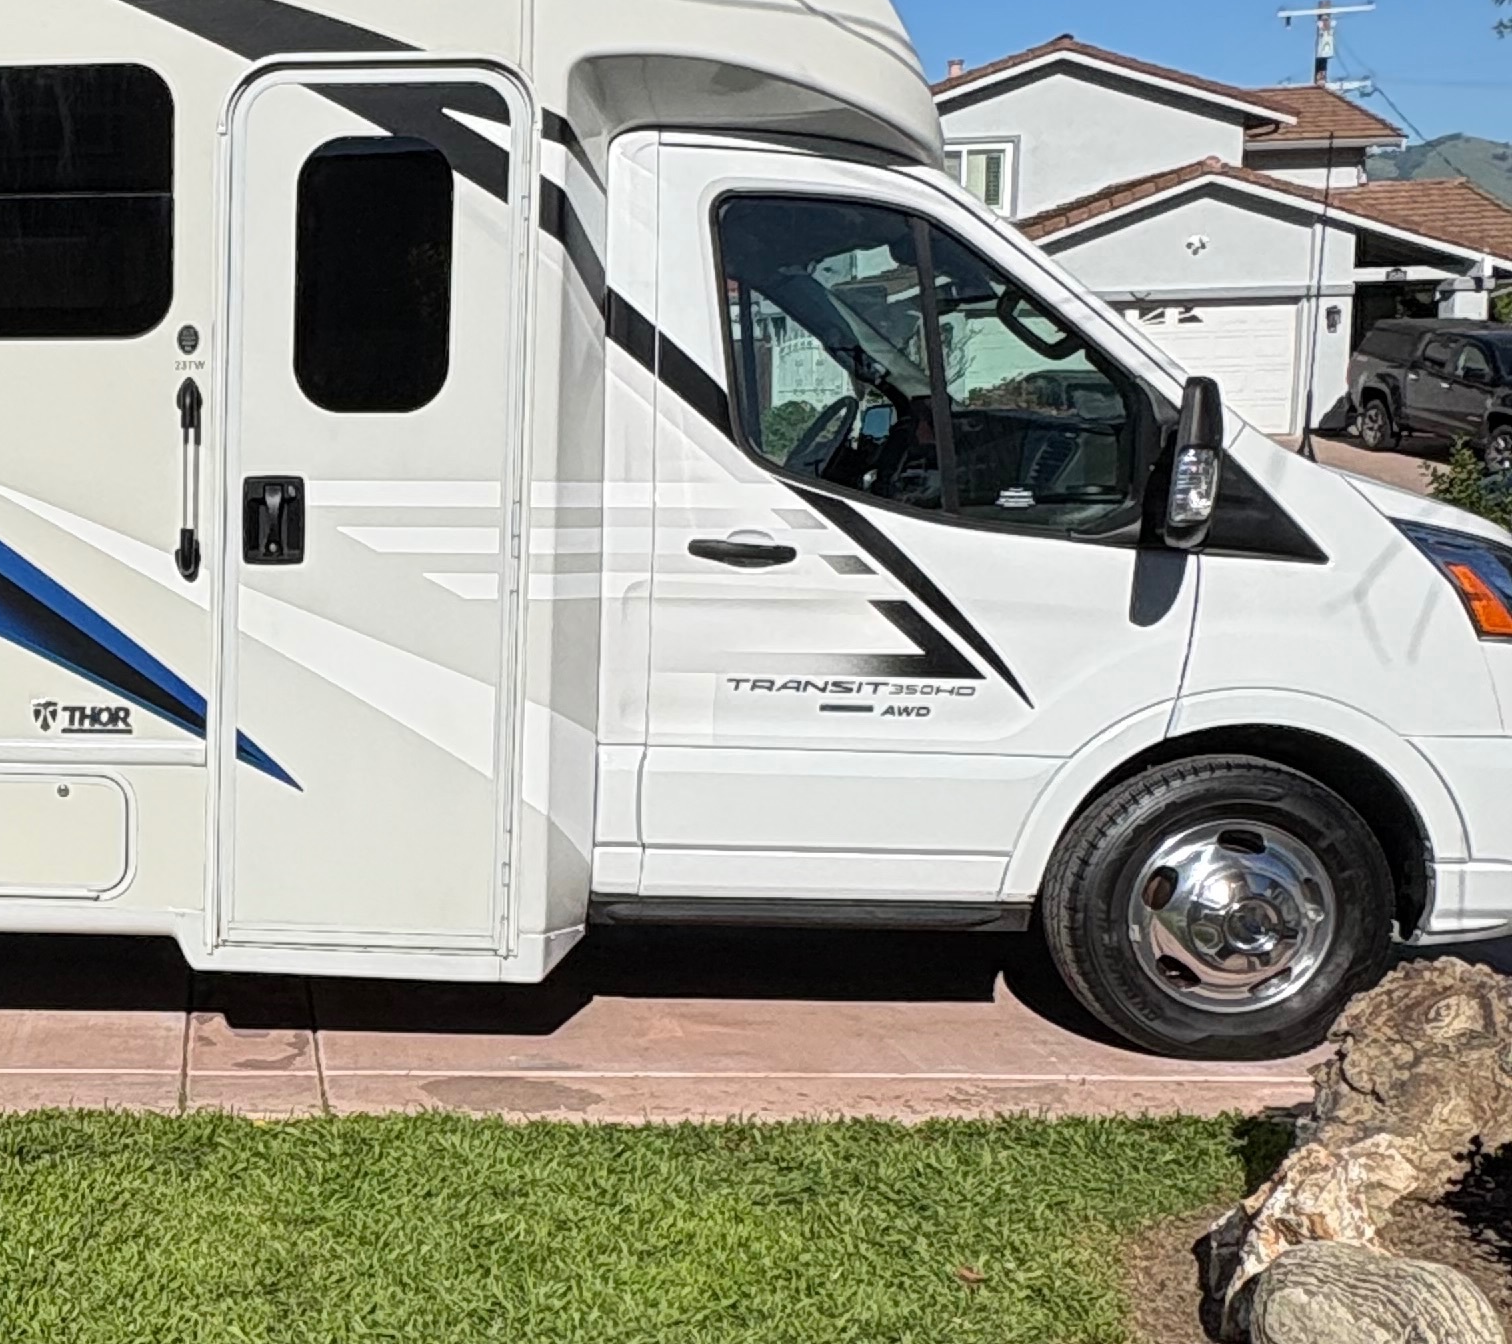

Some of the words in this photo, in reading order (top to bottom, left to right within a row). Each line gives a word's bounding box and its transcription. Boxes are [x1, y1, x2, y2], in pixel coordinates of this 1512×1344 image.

[175, 360, 206, 371] 23TW
[61, 706, 132, 728] THOR
[880, 705, 931, 717] AWD
